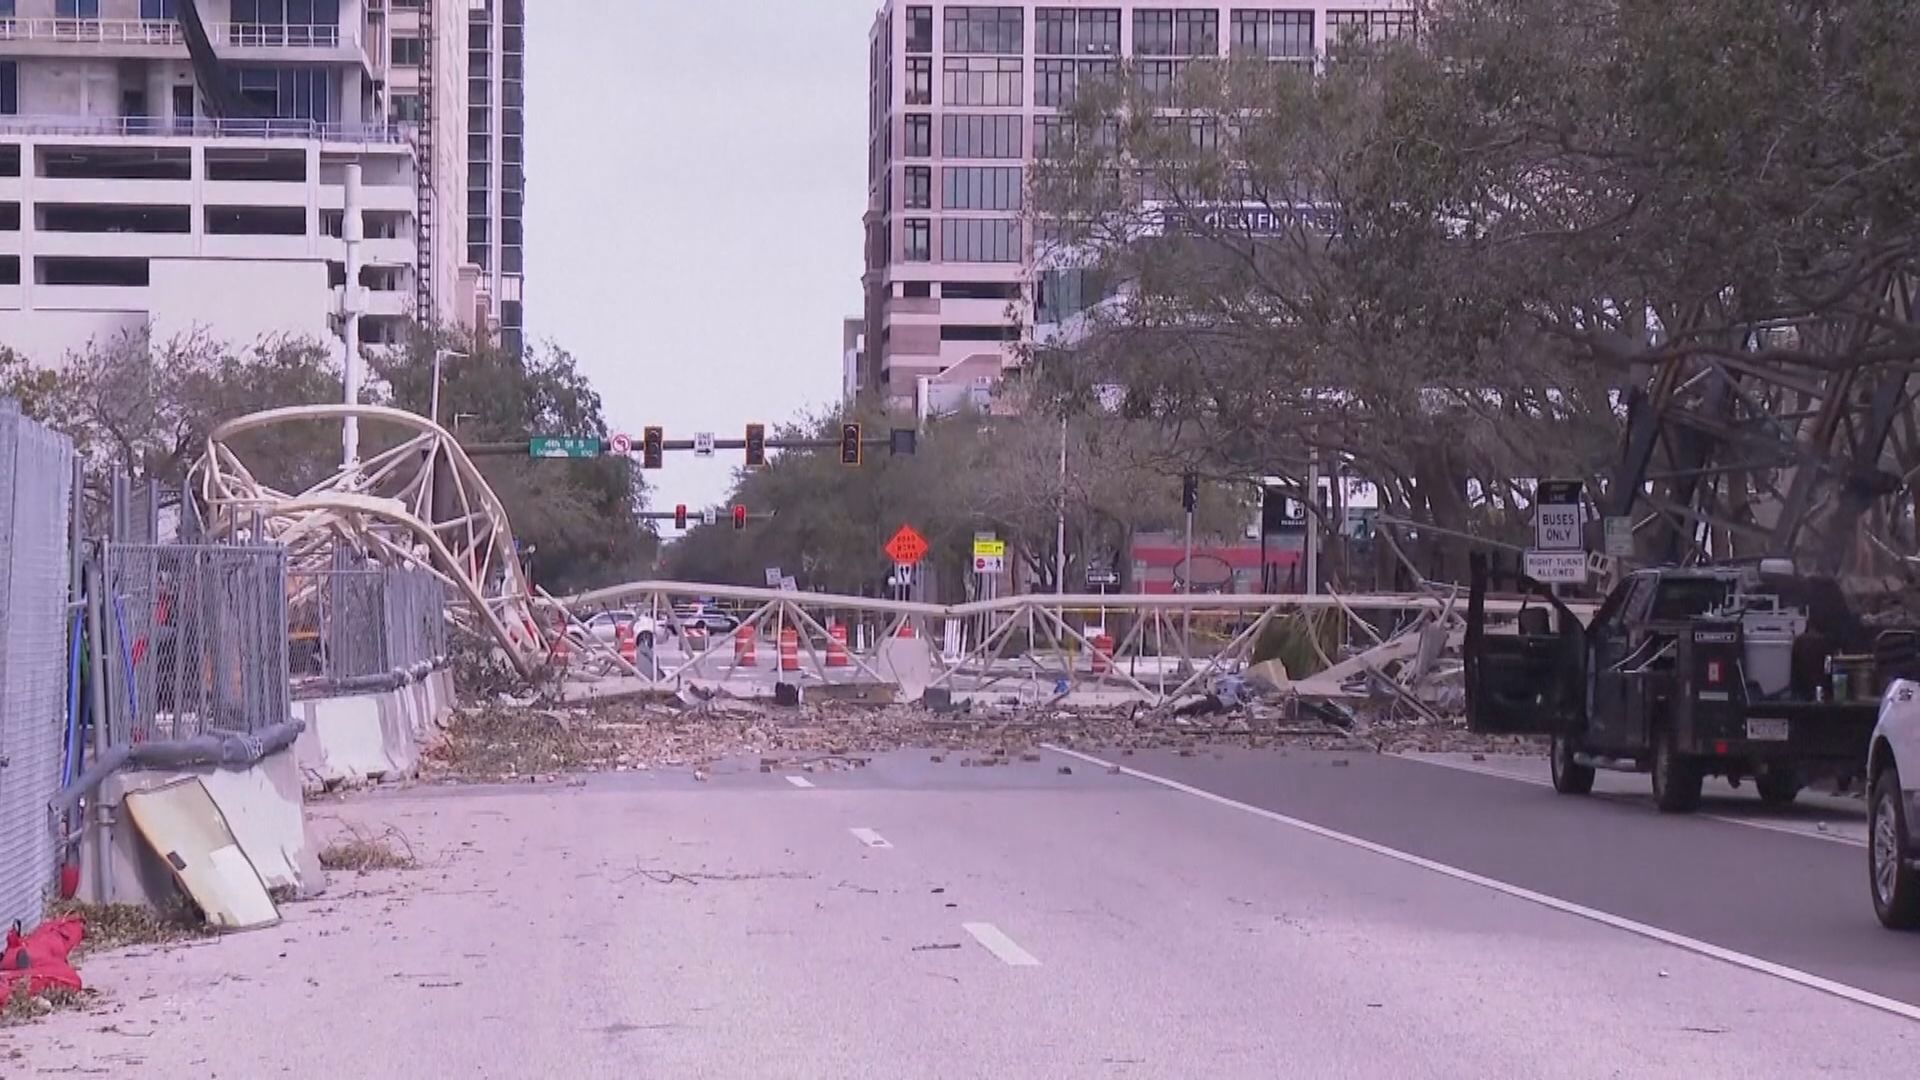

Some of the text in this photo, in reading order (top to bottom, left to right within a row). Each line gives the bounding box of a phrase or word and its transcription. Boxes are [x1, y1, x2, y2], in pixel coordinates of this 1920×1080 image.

[1542, 514, 1575, 526] BUSES
[1546, 528, 1572, 541] ONLY
[897, 535, 916, 543] ROAD
[1529, 559, 1584, 567] RIGHT TURNS
[1536, 569, 1575, 577] ALLOWED
